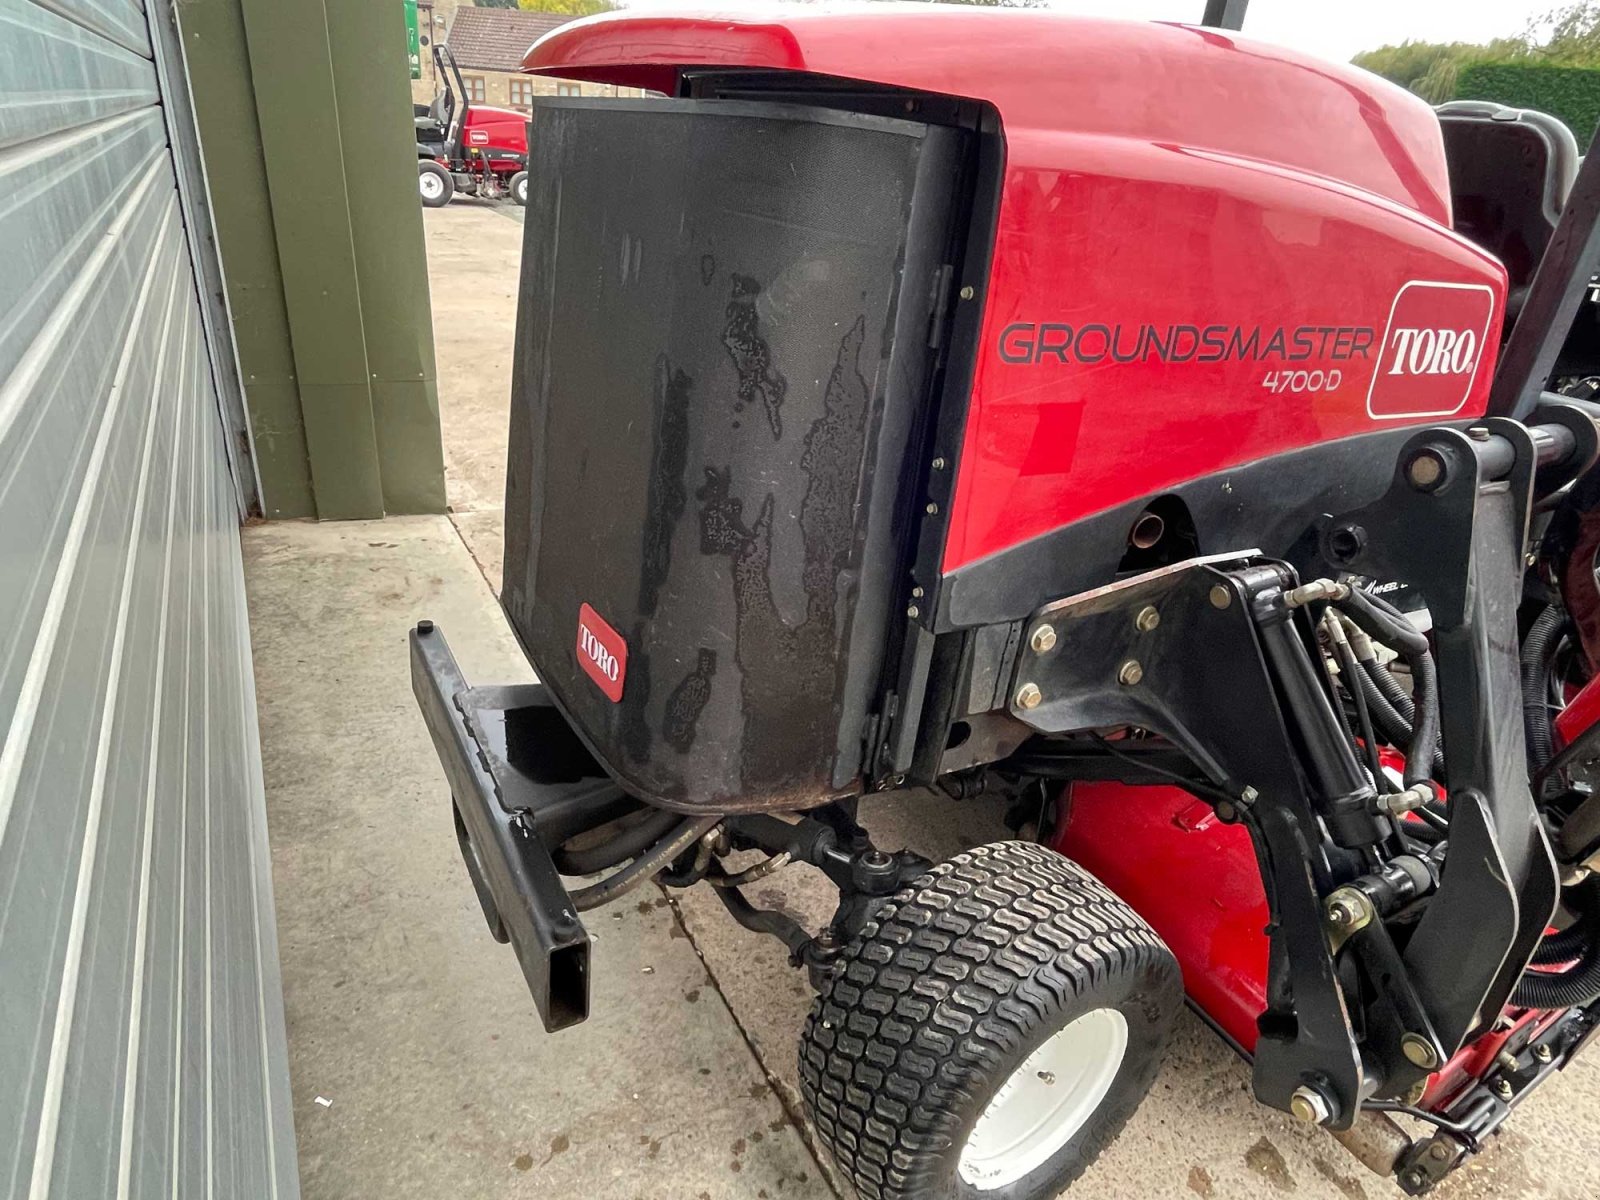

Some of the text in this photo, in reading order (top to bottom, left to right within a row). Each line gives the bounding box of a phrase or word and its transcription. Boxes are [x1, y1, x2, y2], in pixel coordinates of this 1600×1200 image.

[998, 322, 1374, 365] GROUNDSMASTER
[1387, 328, 1475, 375] TORO
[580, 623, 619, 682] TORO
